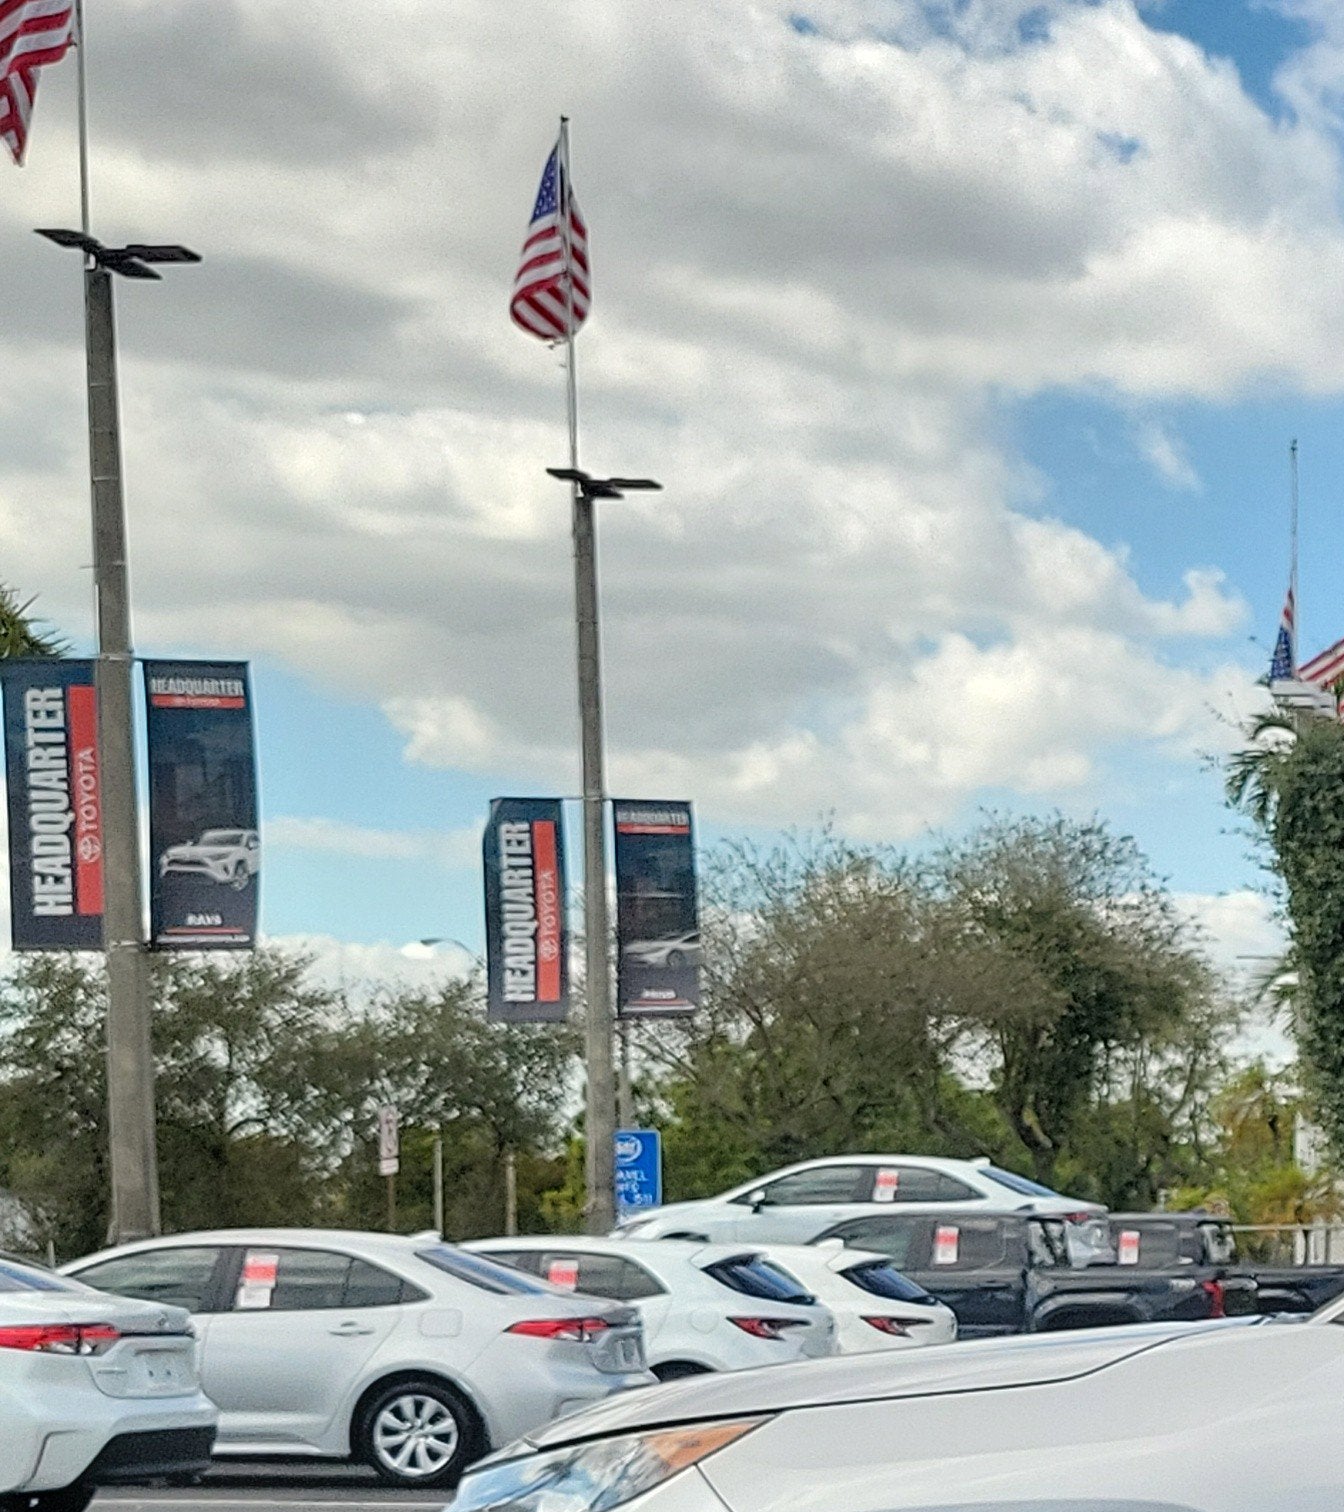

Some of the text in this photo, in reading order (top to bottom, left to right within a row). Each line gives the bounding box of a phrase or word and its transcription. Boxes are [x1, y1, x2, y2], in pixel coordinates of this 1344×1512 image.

[26, 686, 75, 917] HEADQUARTER
[78, 748, 98, 832] TOYOTA
[500, 822, 537, 1003] HEADQUARTER
[539, 873, 557, 934] TOYOTA
